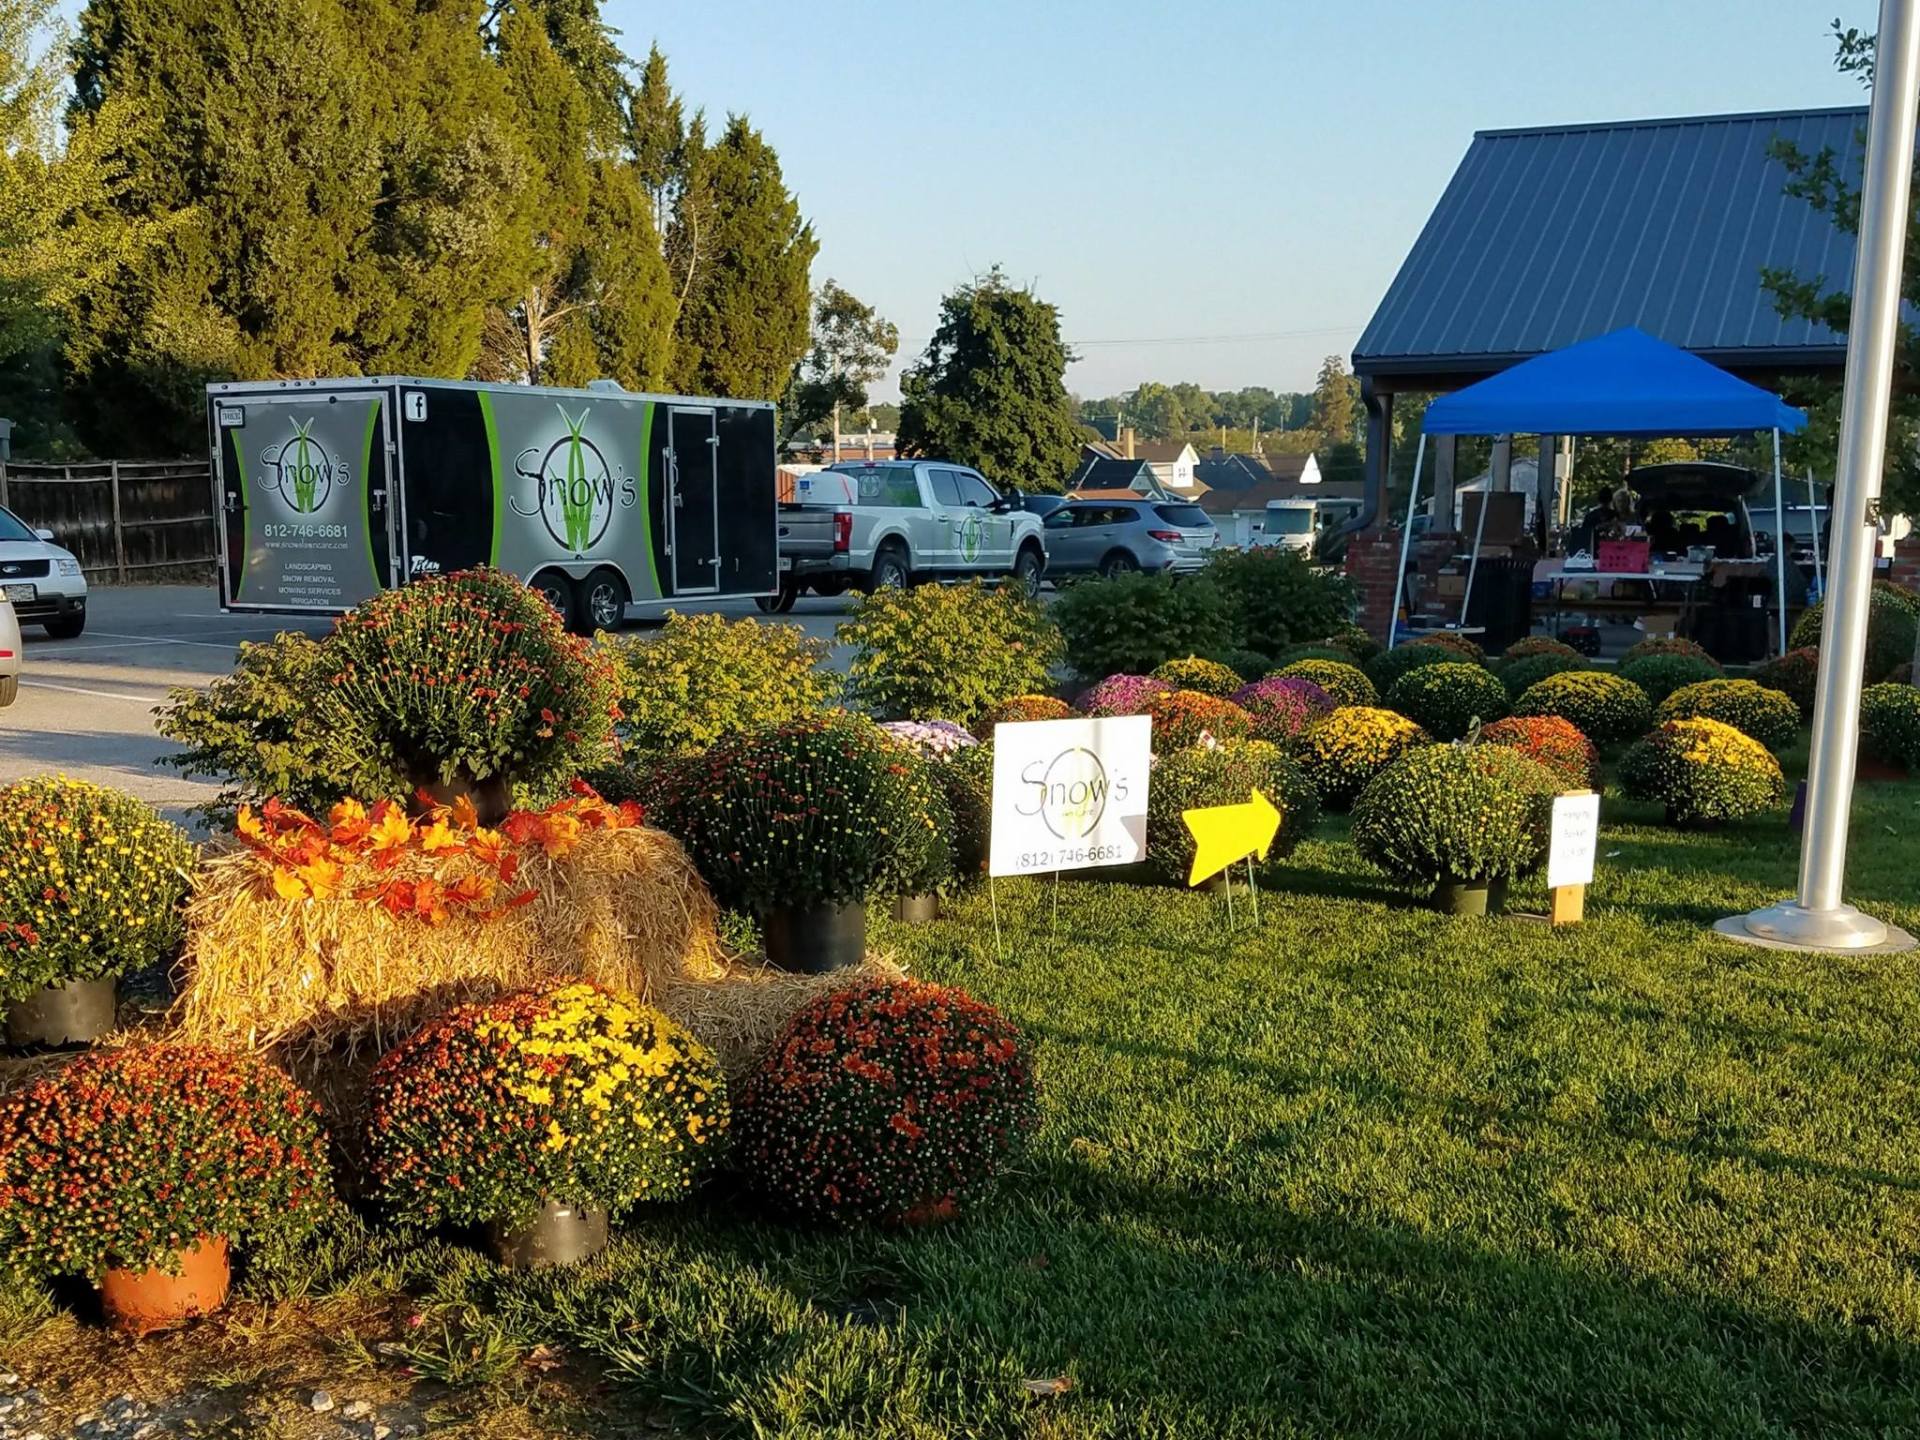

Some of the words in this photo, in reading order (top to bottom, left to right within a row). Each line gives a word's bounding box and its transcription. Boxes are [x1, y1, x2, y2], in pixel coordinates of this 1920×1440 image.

[258, 445, 350, 490] Snow's
[510, 448, 636, 516] Snow's
[264, 524, 348, 538] 812-746-6681
[1014, 759, 1129, 816] Snow's
[1058, 844, 1123, 865] 746-6681
